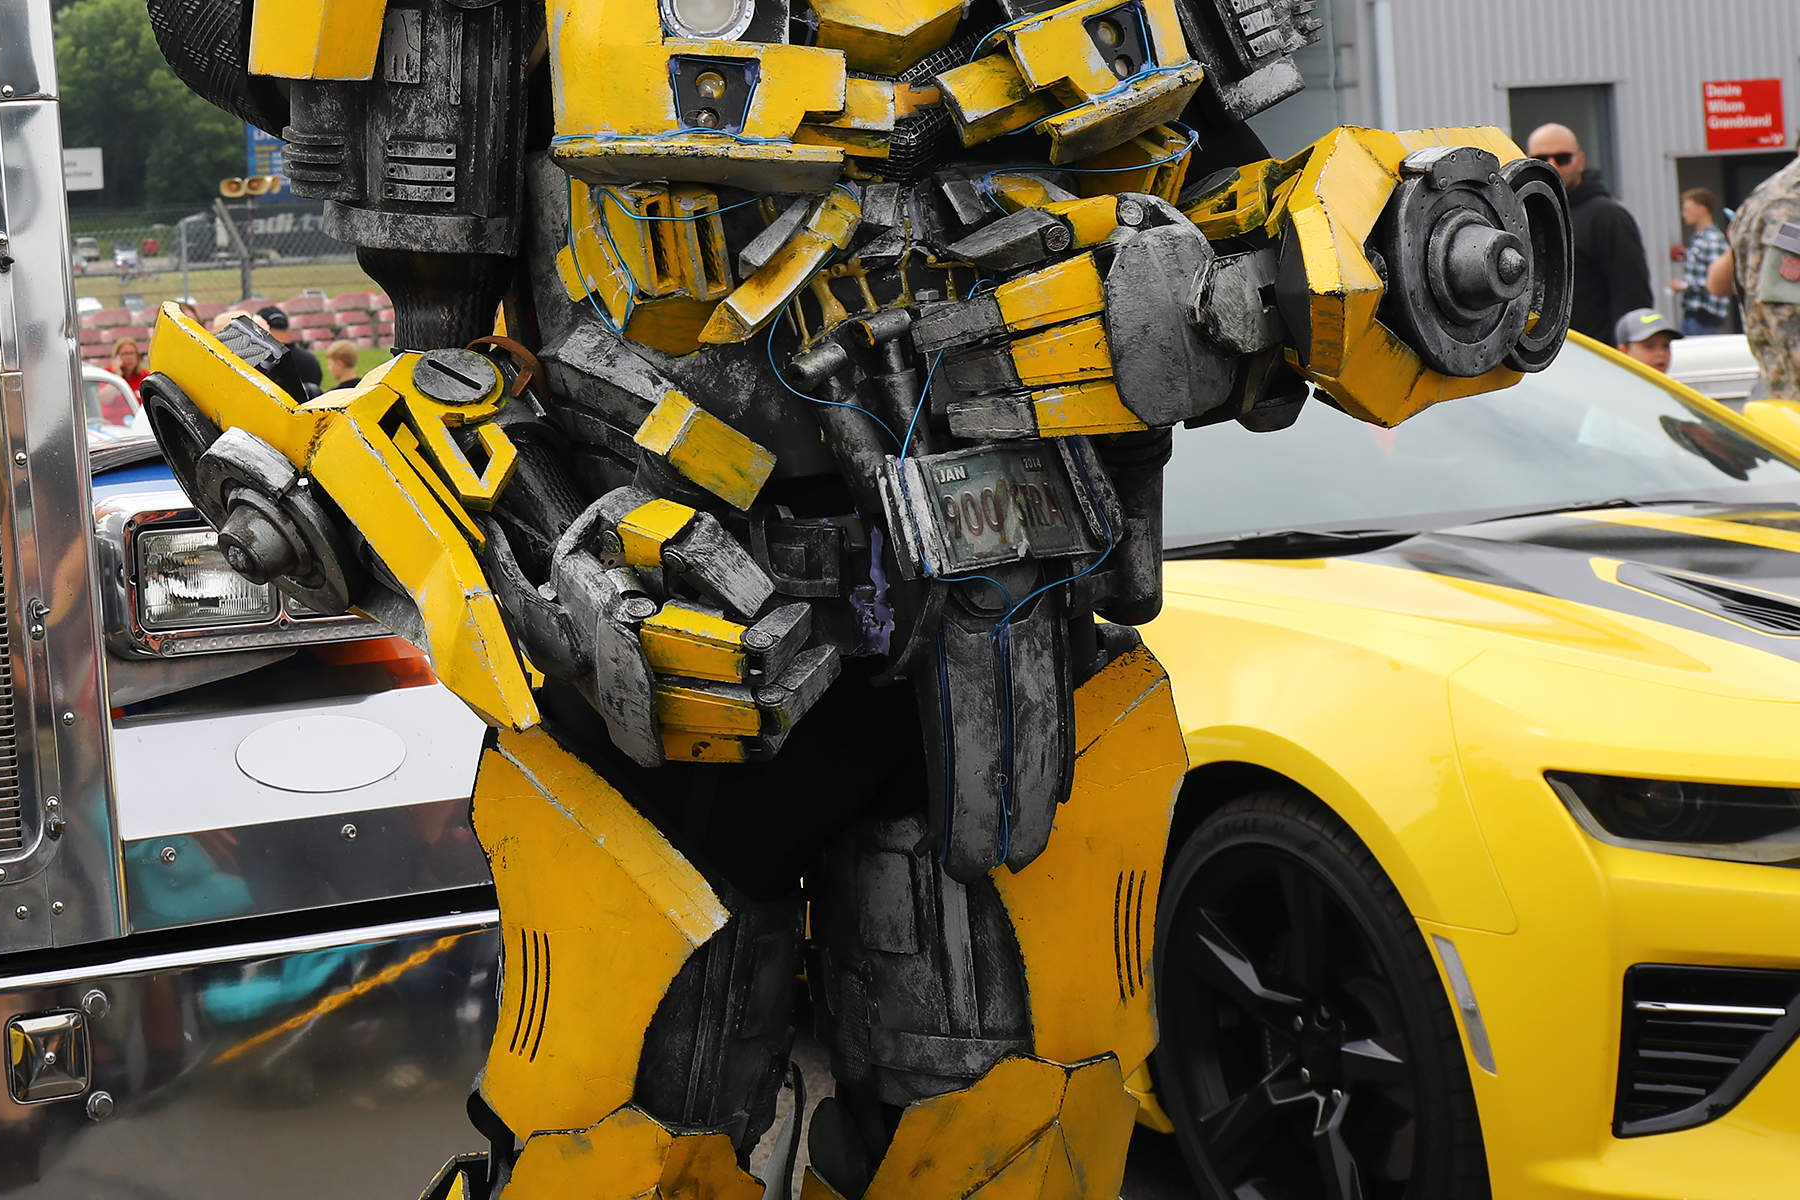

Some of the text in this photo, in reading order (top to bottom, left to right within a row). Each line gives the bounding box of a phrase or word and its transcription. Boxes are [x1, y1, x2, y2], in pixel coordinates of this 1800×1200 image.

[1705, 83, 1742, 98] Desire
[1707, 98, 1745, 113] Wilson
[1708, 112, 1772, 130] Grandstand
[940, 456, 1042, 483] JAN 2014
[942, 486, 1006, 539] 900
